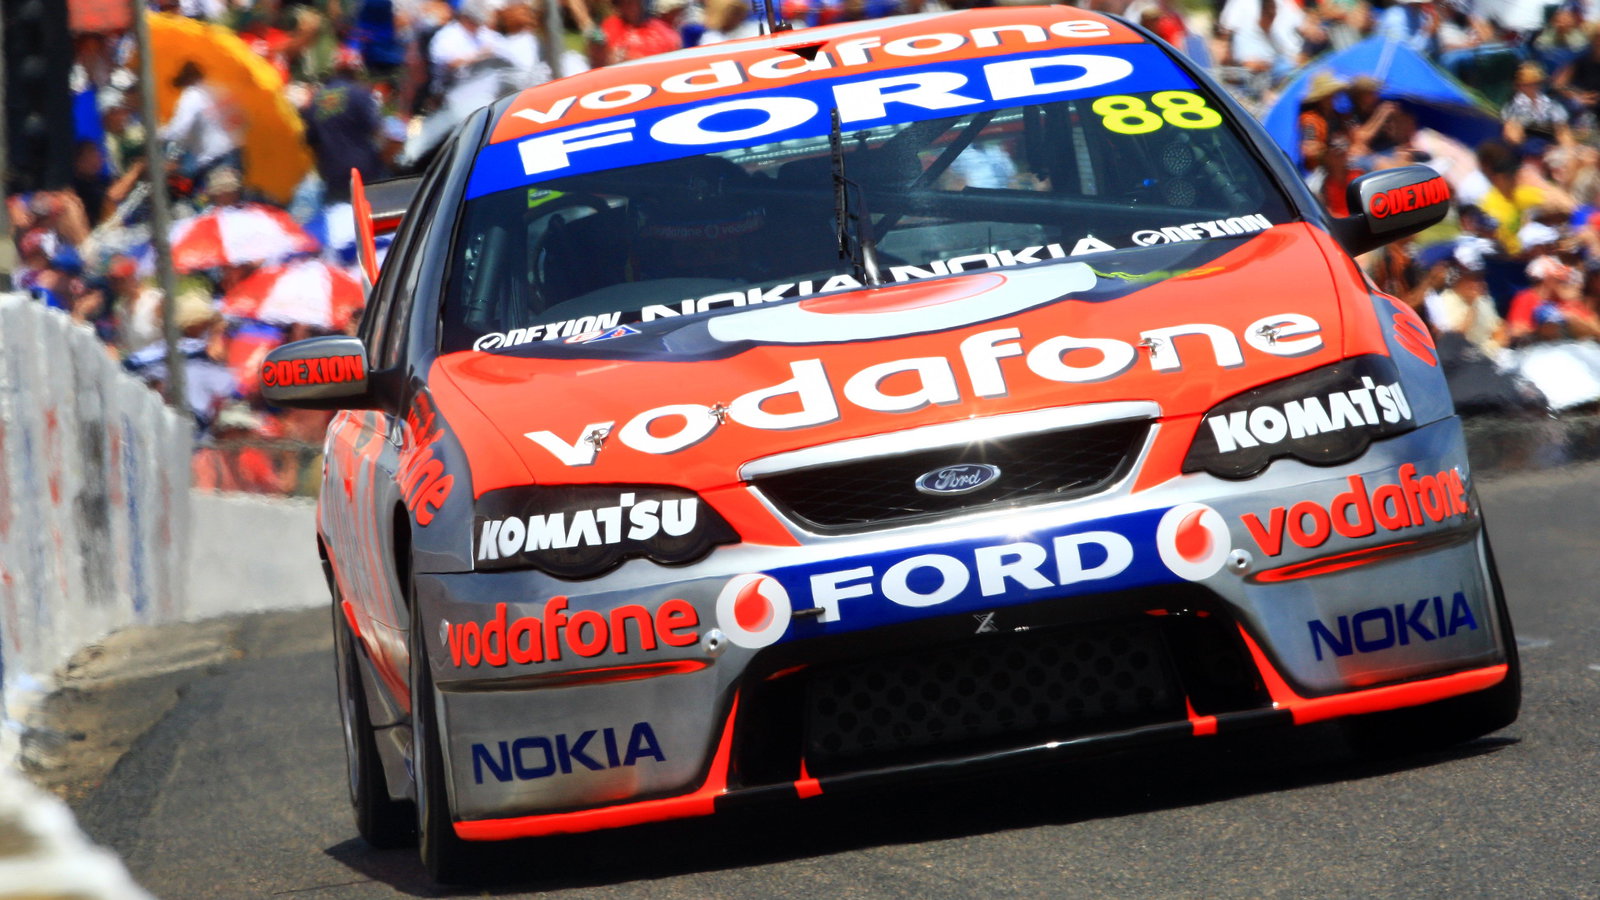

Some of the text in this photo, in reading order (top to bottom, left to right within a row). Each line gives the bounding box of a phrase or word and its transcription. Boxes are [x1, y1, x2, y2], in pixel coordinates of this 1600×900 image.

[512, 20, 1111, 125] vodafone
[519, 54, 1134, 175] FORD
[1092, 91, 1223, 135] 88
[890, 237, 1116, 283] NOKIA
[642, 274, 862, 322] NOKIA
[276, 354, 365, 386] DEXION
[524, 312, 1324, 467] vodafone
[1208, 376, 1412, 453] KOMATSU
[934, 467, 981, 489] Ford
[1241, 463, 1468, 557] vodafone
[478, 492, 698, 561] KOMATSU
[810, 530, 1134, 623] FORD
[448, 596, 701, 668] vodafone
[1307, 592, 1478, 662] NOKIA
[472, 722, 666, 784] NOKIA
